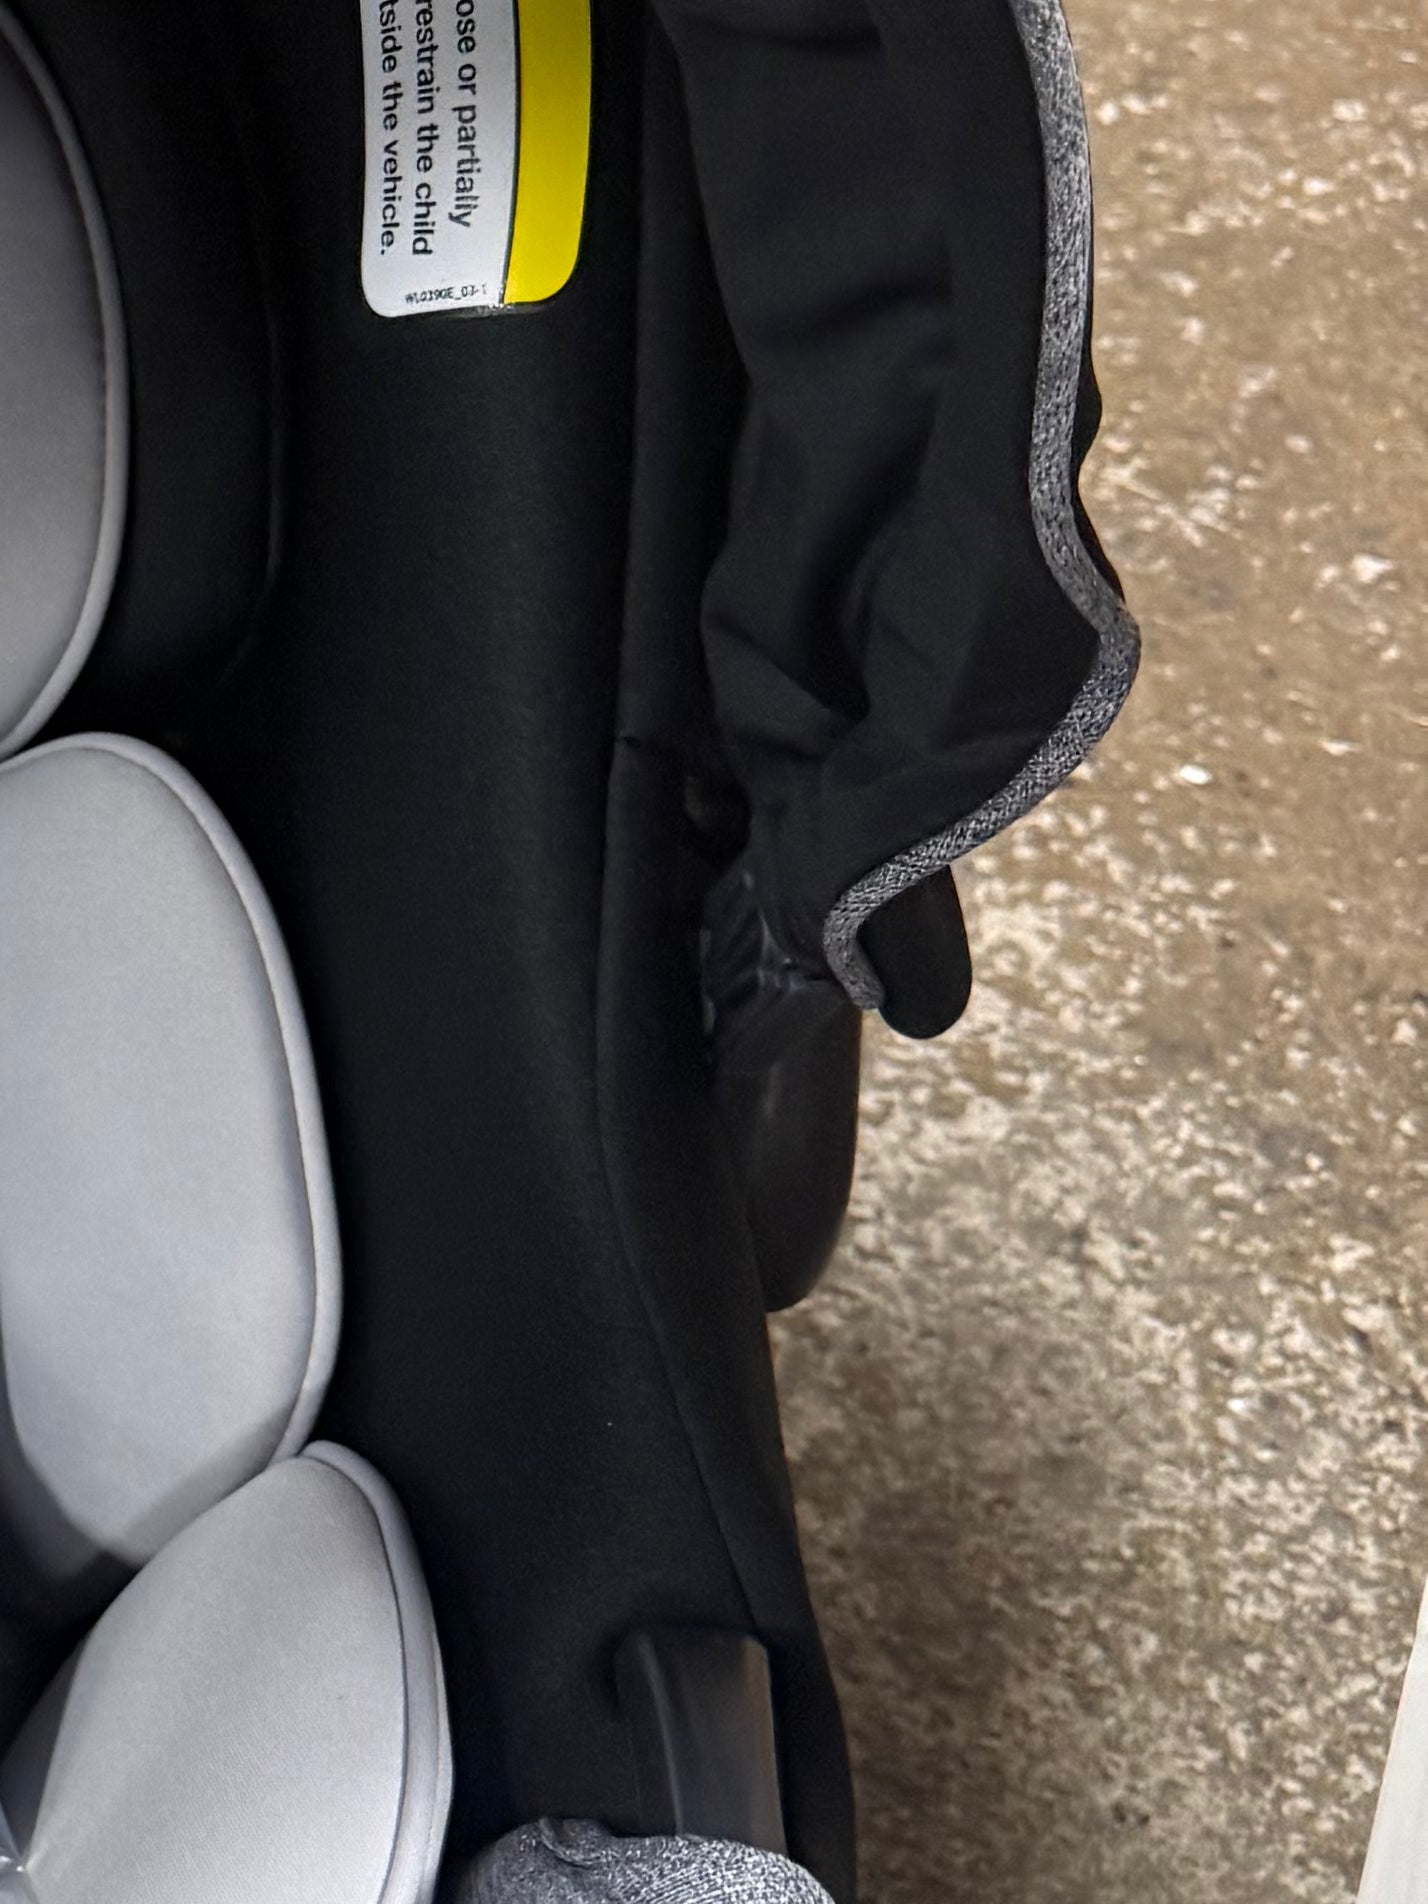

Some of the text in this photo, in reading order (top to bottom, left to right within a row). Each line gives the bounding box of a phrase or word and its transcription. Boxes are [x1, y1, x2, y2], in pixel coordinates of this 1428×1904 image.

[382, 81, 404, 131] the
[458, 63, 477, 95] or
[416, 123, 439, 173] the
[449, 104, 481, 228] partially
[380, 139, 402, 256] vehicle.
[412, 182, 436, 255] child
